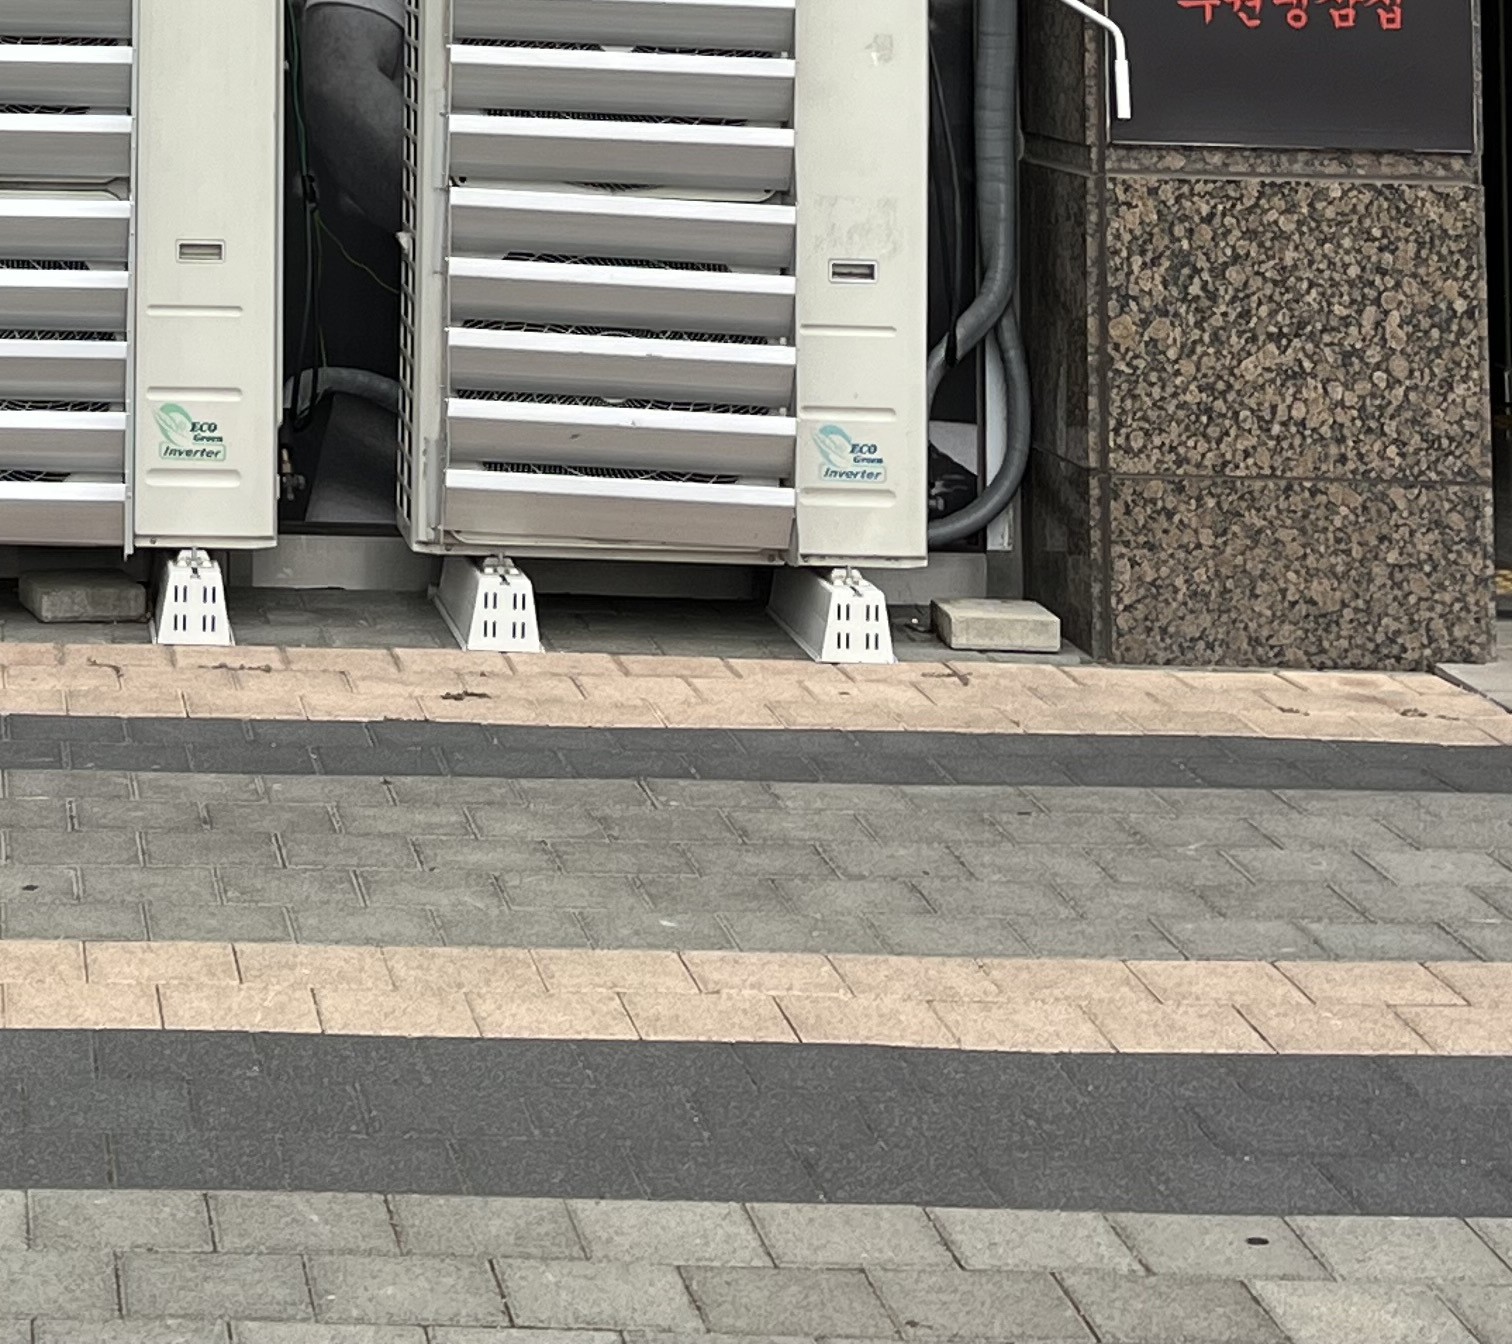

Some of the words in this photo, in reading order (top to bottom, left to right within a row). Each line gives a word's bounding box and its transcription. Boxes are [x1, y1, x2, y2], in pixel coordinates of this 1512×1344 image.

[190, 422, 218, 433] ECO
[193, 433, 223, 442] Green
[163, 446, 221, 458] Inverter
[849, 443, 878, 455] ECO
[853, 455, 884, 464] Green
[823, 468, 882, 480] Inverter
